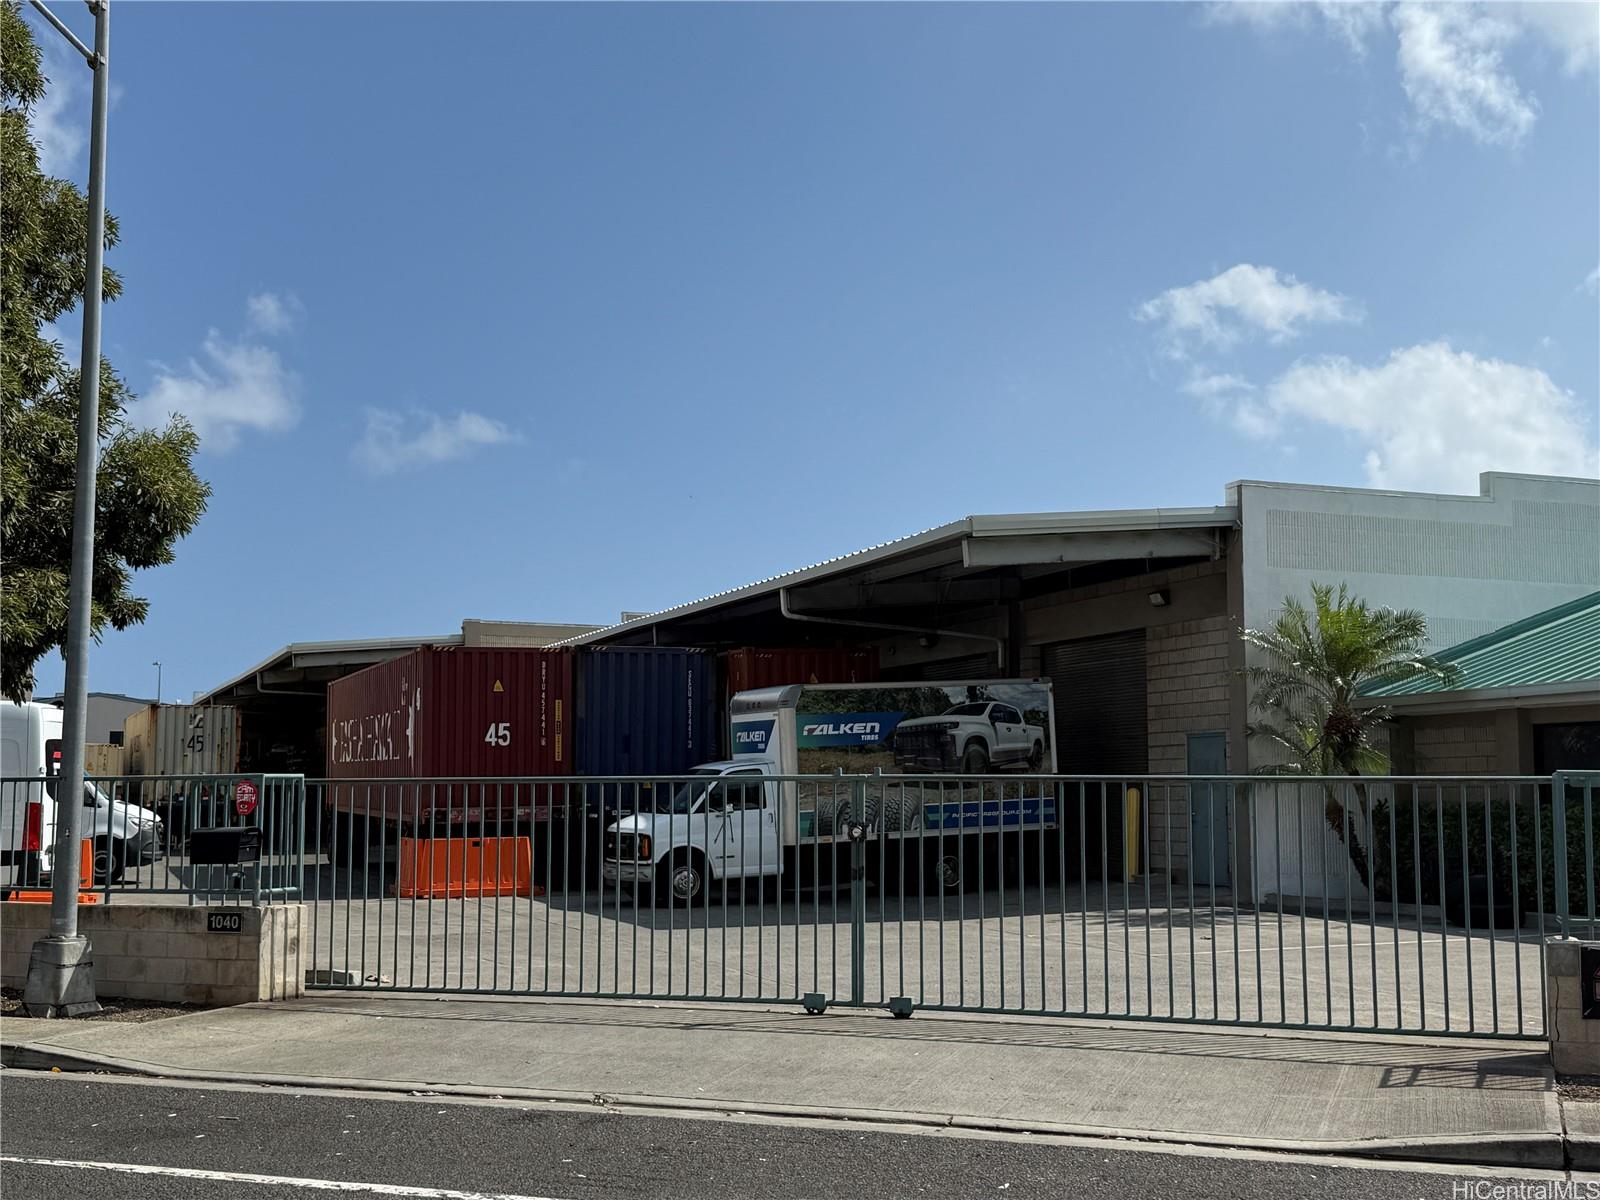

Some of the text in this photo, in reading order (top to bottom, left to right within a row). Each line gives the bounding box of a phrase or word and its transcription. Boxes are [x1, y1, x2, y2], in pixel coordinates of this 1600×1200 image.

[485, 723, 510, 746] 45
[803, 722, 880, 736] FALKEN
[187, 735, 204, 752] 45
[736, 730, 765, 743] FALKEN
[210, 915, 239, 929] 1040
